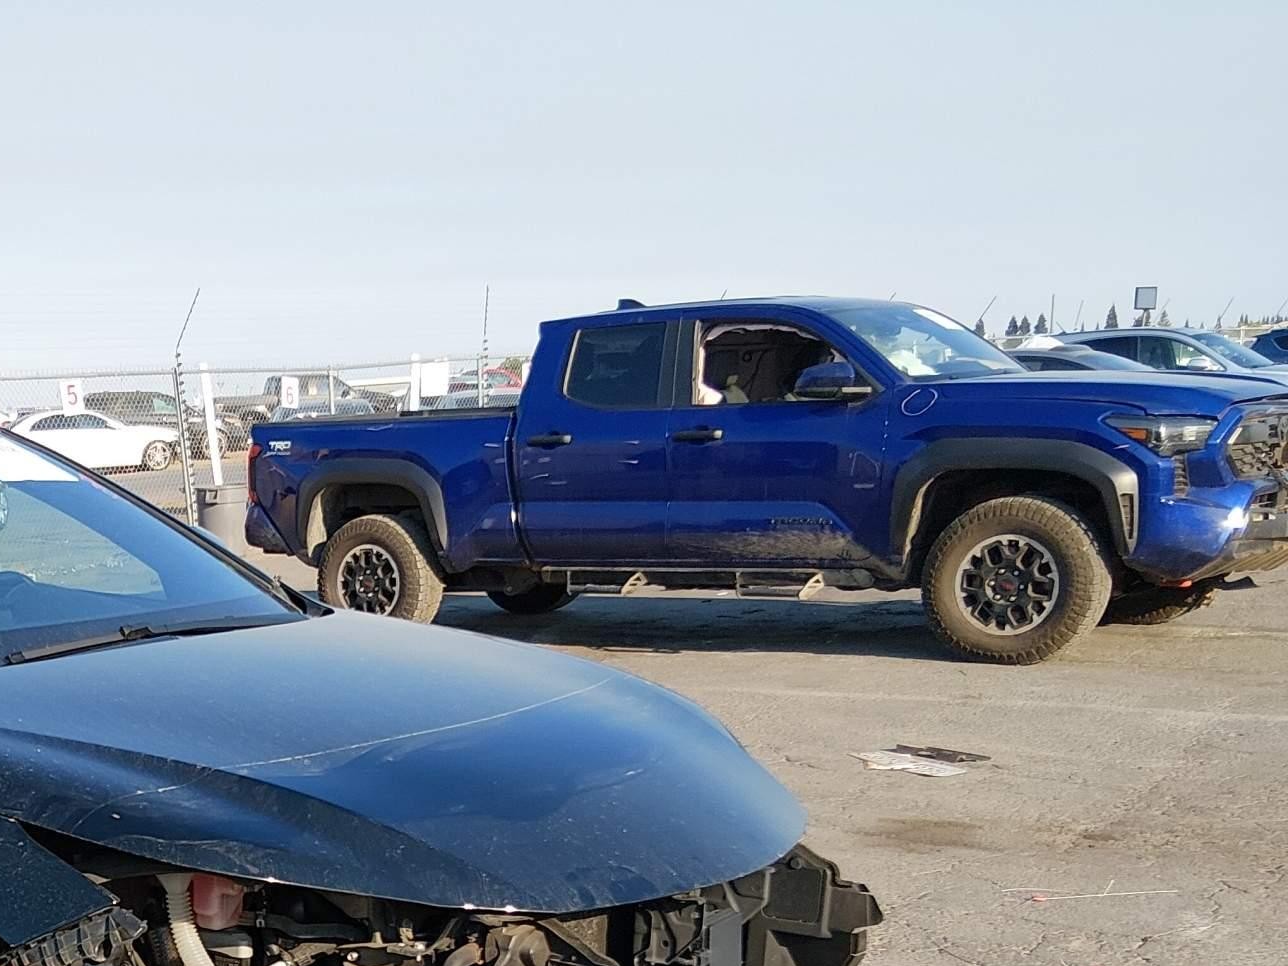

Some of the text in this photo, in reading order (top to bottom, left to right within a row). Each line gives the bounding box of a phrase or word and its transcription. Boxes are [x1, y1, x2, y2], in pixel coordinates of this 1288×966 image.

[67, 384, 78, 405] 5
[286, 386, 294, 405] 6
[268, 441, 291, 451] TRD
